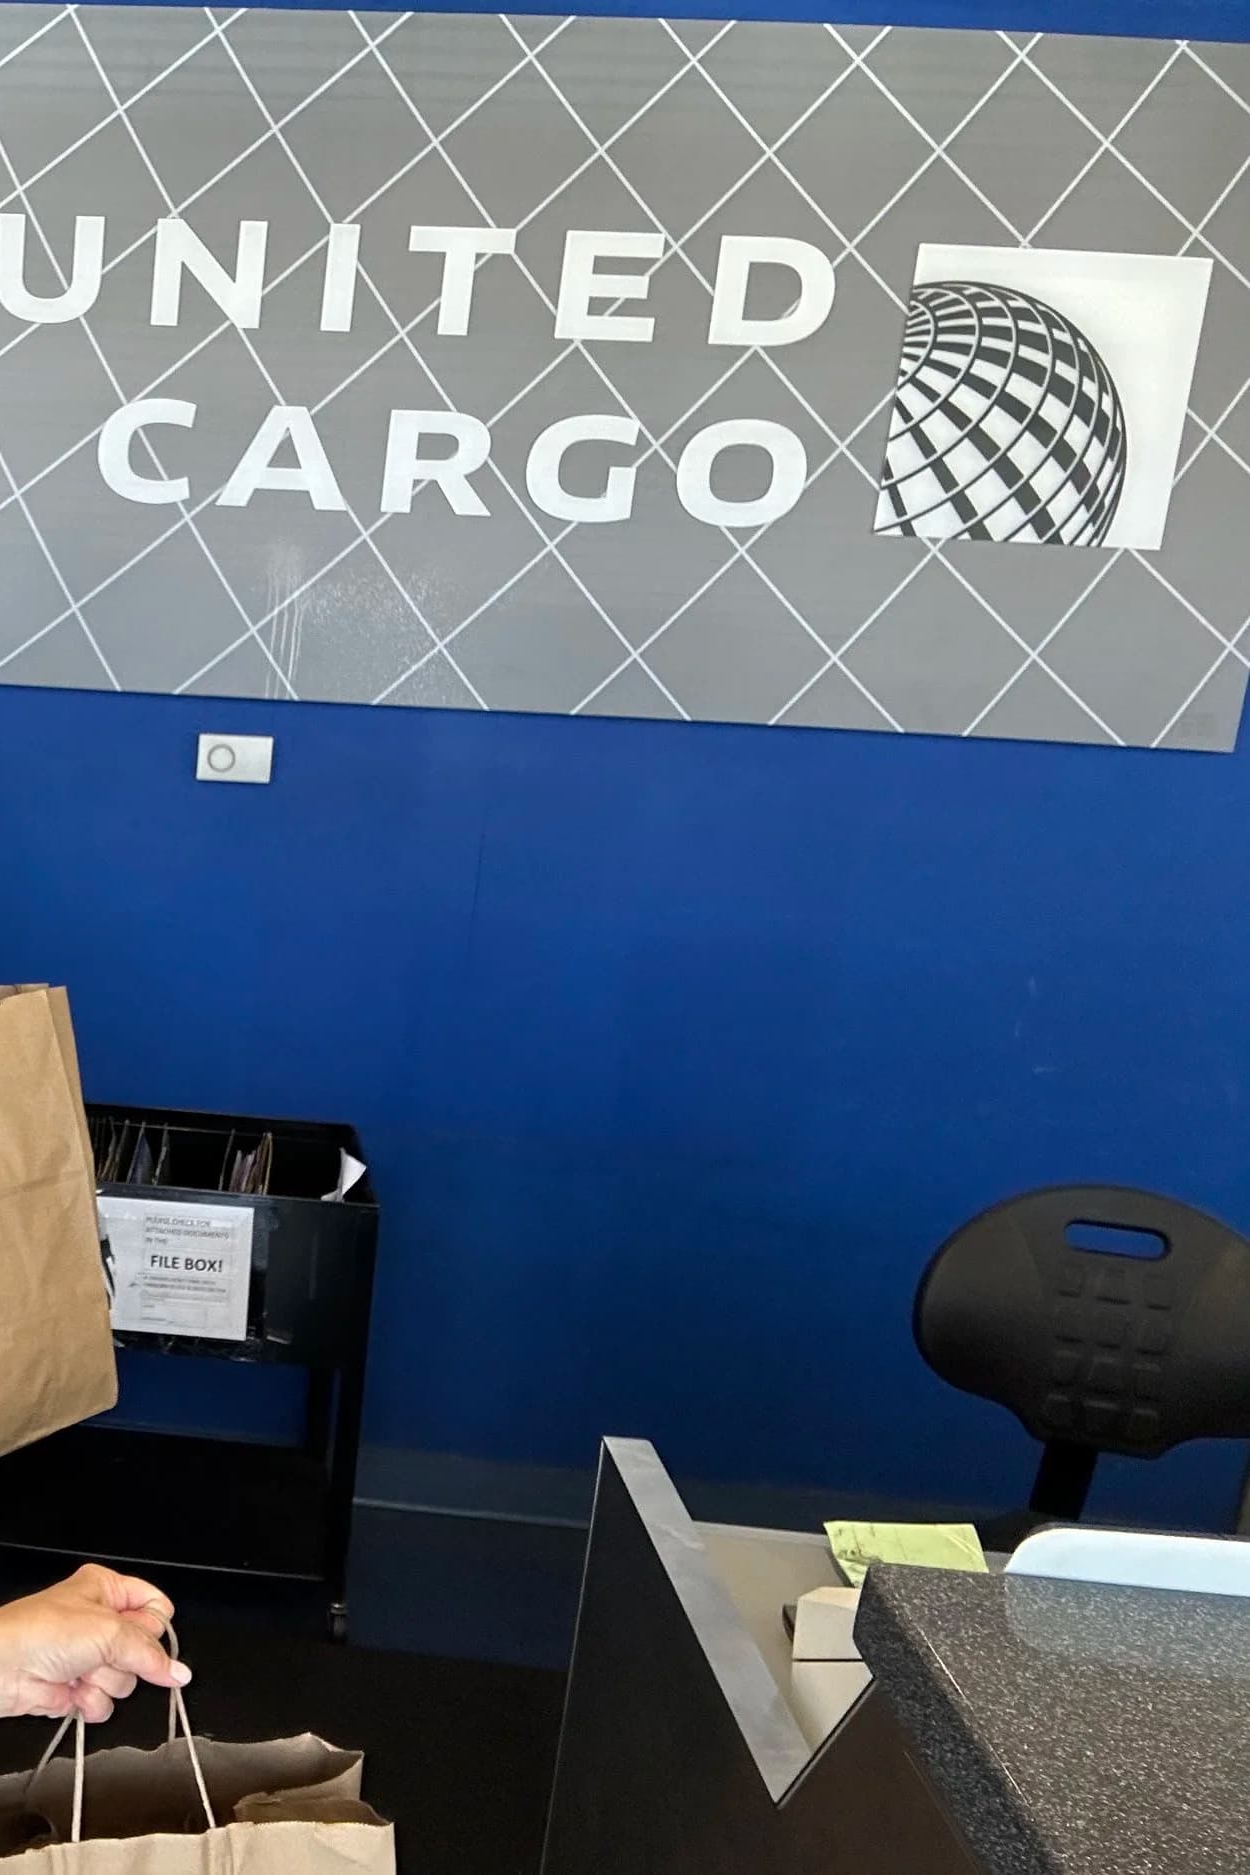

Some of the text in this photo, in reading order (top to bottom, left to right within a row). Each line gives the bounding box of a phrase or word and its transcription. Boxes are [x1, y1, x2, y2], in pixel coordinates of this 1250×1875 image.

[97, 398, 808, 530] CARGO
[150, 1255, 223, 1273] FILE BOX!
